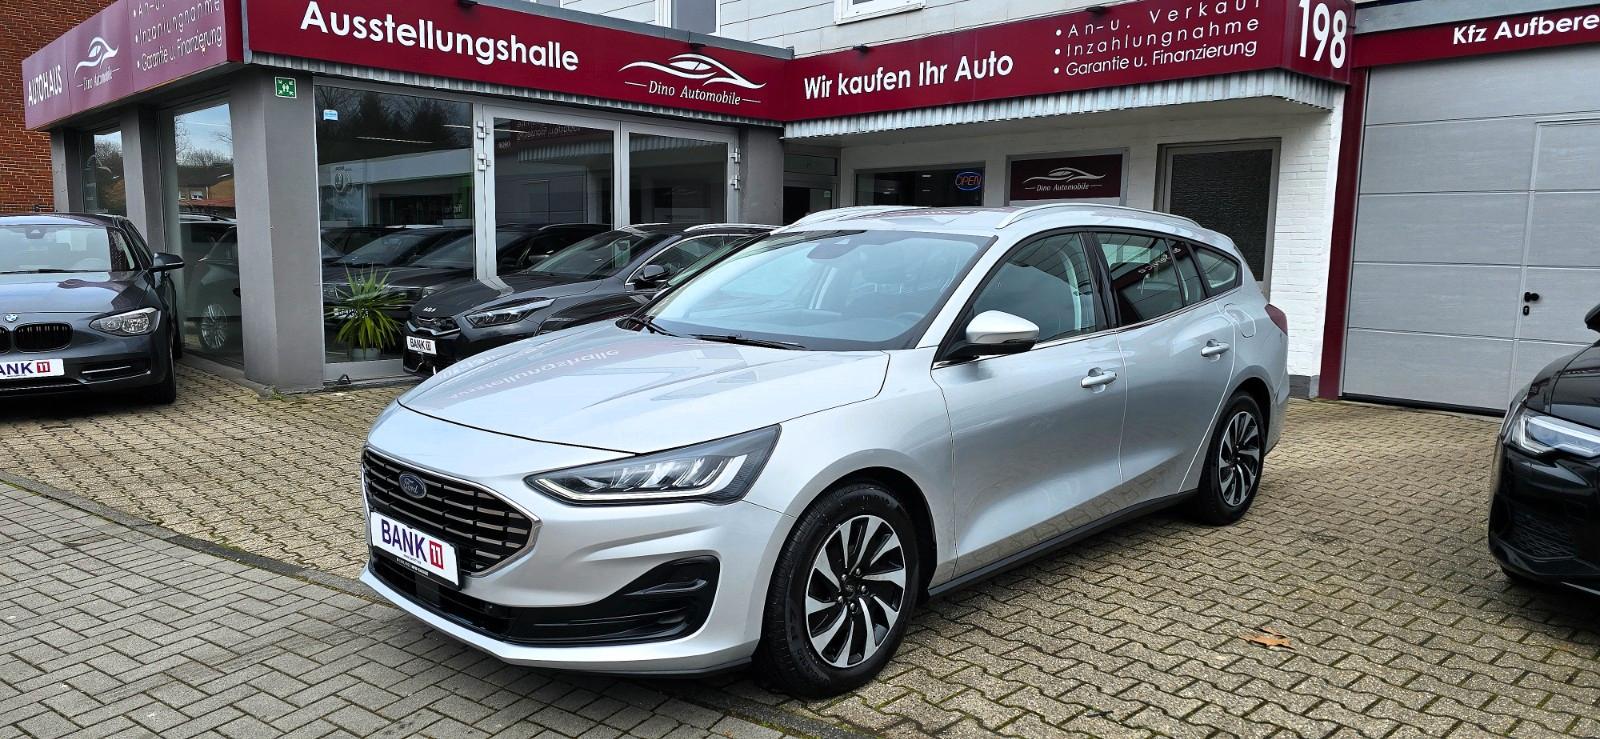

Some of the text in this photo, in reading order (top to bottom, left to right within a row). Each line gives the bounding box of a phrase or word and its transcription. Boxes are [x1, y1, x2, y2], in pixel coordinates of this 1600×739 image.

[300, 0, 579, 72] Ausstellungshalle
[1065, 17, 1260, 57] Inzahlungnahme
[1298, 0, 1348, 69] 198
[1453, 26, 1487, 45] Kfz
[804, 50, 1014, 100] Wir kaufen Ihr Auto
[1065, 39, 1258, 77] Garantie u. Finanzierung
[28, 64, 63, 108] AUTOHAUS
[648, 80, 741, 106] Dino Automobile
[955, 175, 982, 187] OPEN
[1036, 182, 1090, 193] Dino Automobile
[381, 518, 428, 563] BANK
